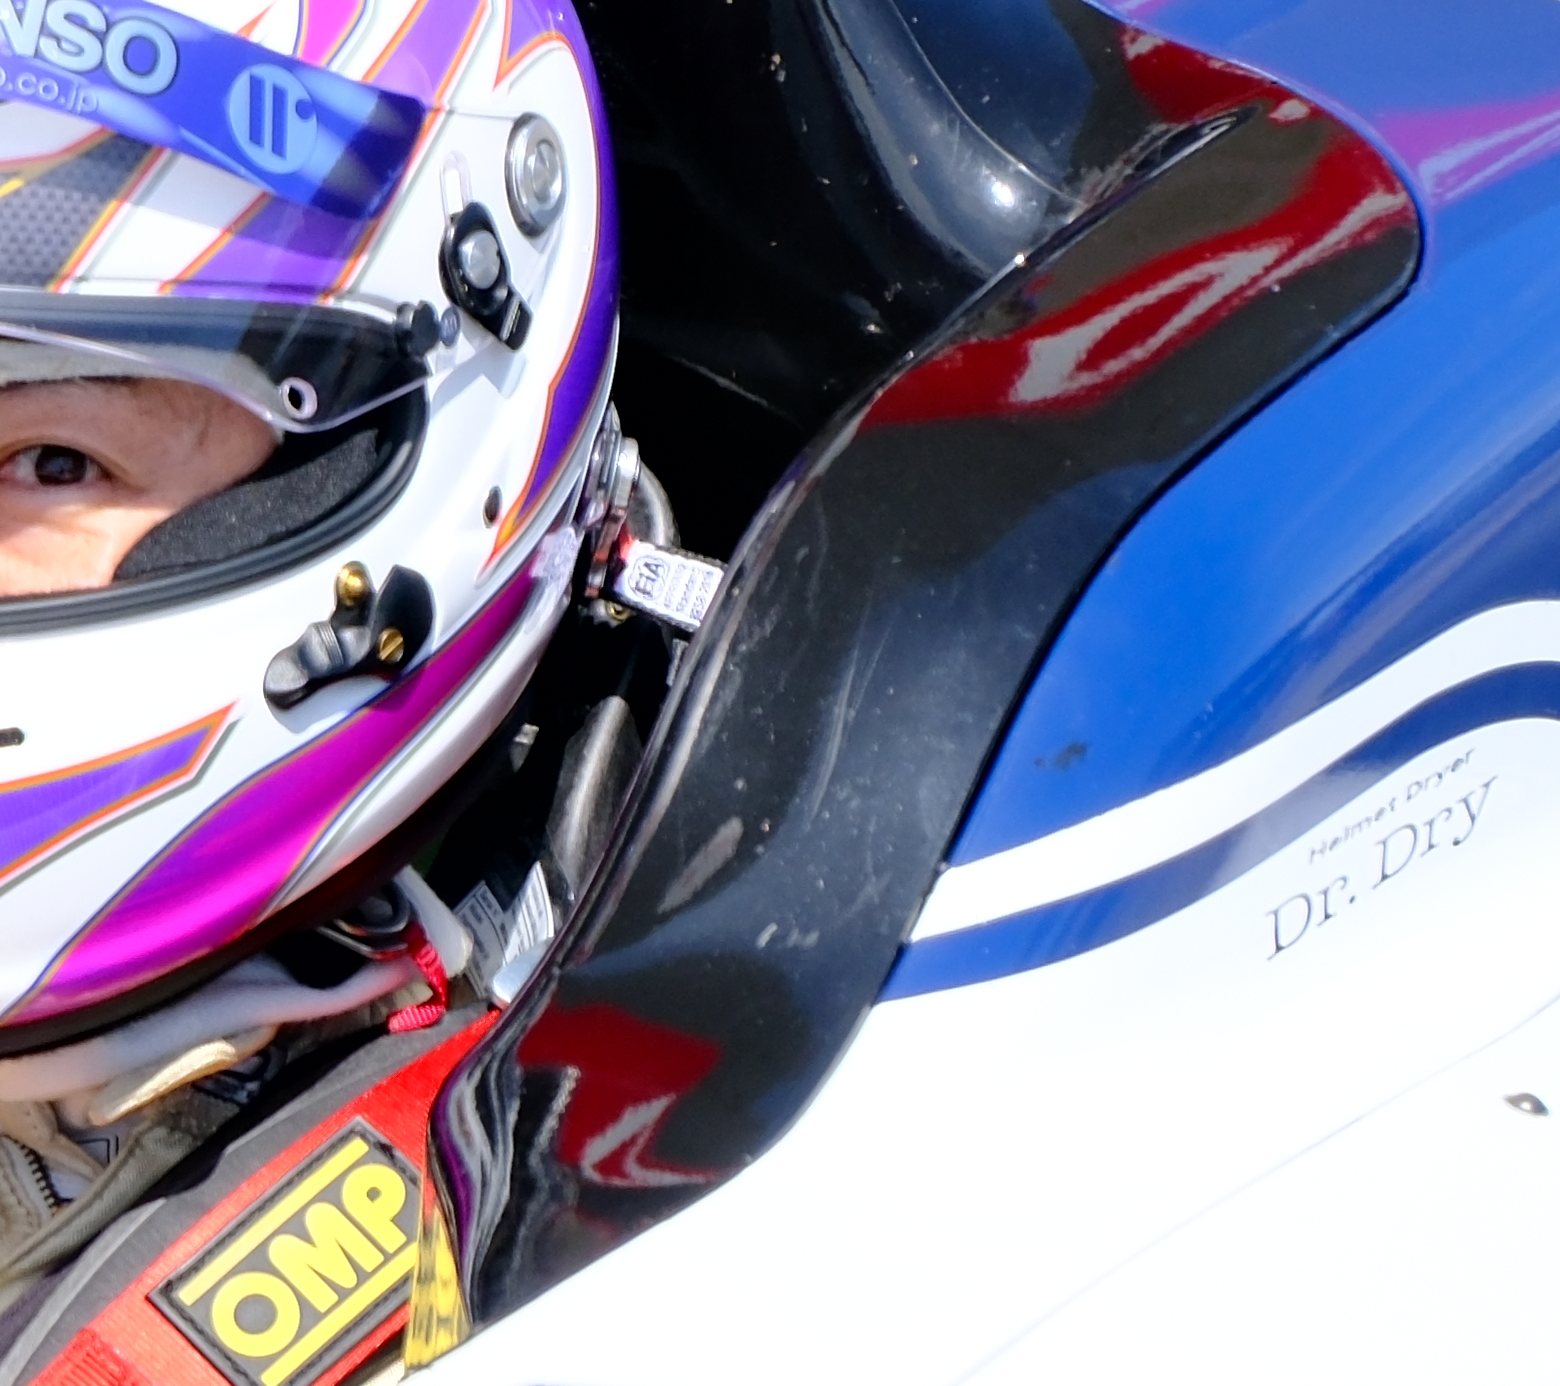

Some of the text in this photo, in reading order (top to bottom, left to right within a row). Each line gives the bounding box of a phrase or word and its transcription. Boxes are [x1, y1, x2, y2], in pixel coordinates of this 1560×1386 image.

[1265, 774, 1499, 962] Dr. Dry
[1309, 746, 1476, 865] Helmet Dryer
[210, 1163, 407, 1358] OMP
